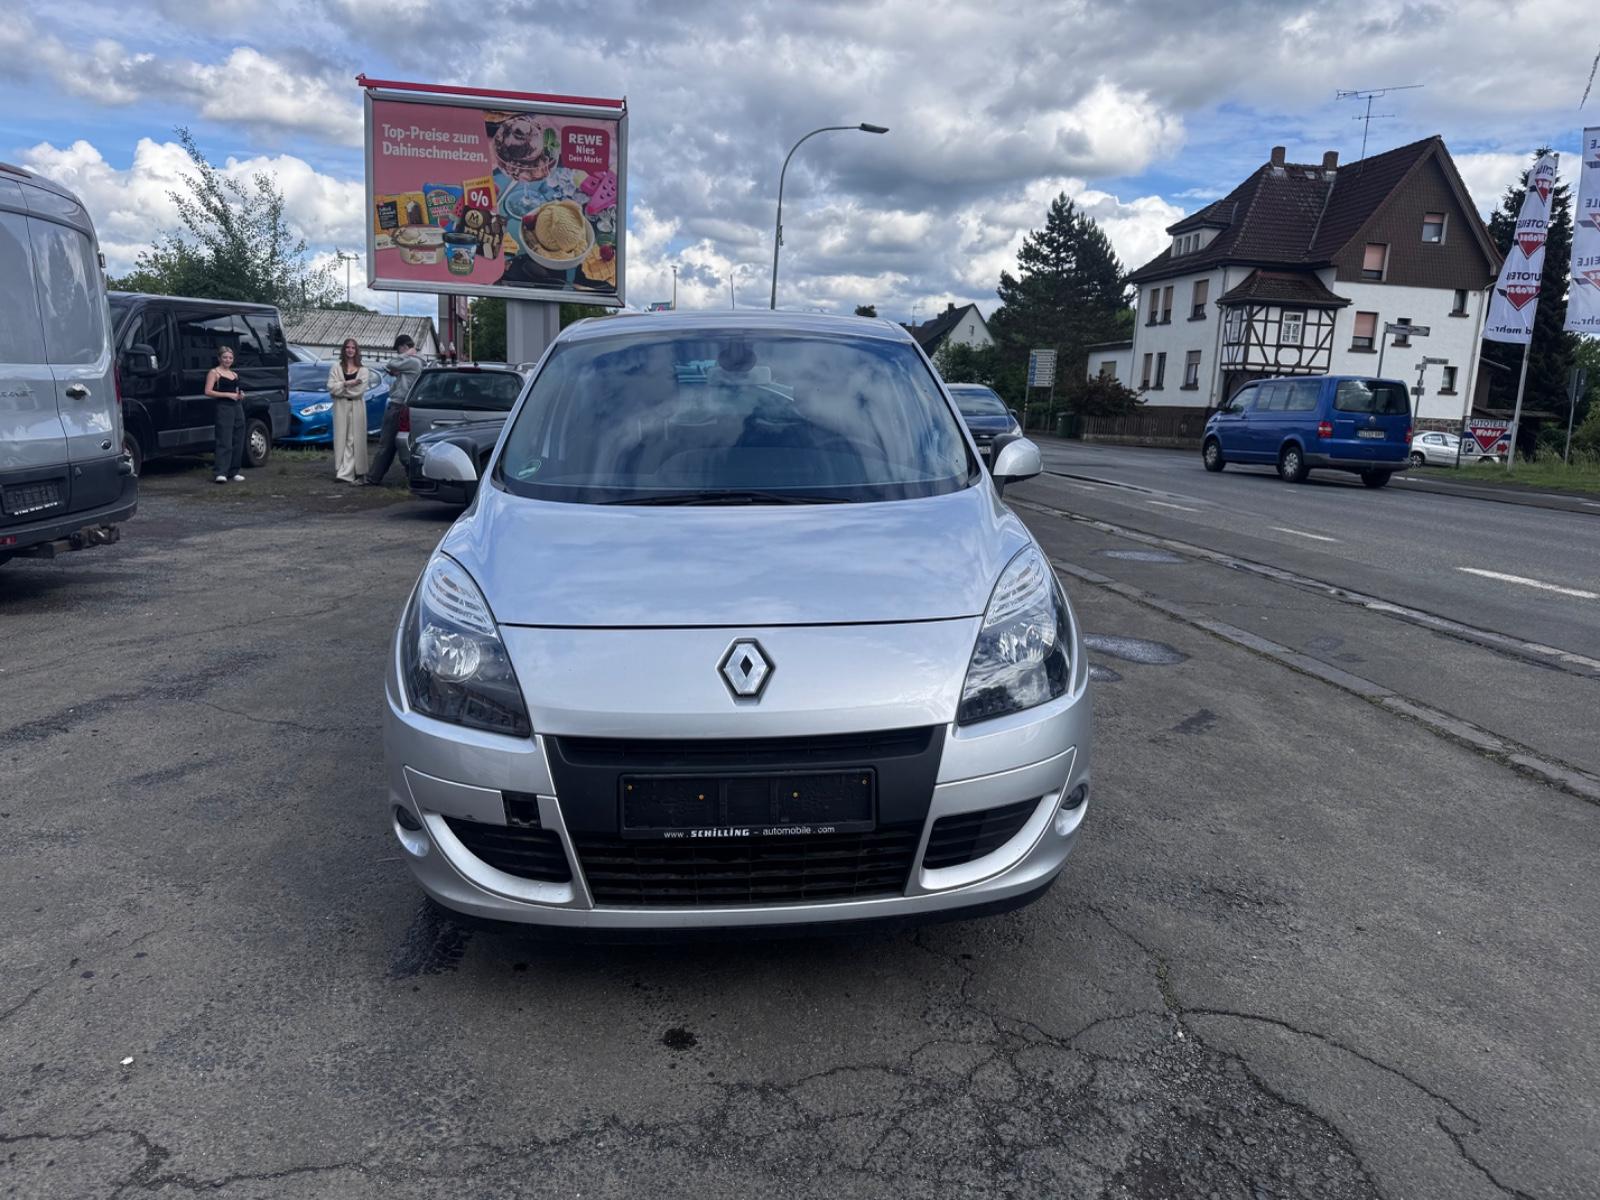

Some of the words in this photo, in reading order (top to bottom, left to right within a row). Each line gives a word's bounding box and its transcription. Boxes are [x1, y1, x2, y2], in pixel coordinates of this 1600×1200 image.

[382, 123, 450, 142] Top-Preise
[452, 132, 480, 145] zum
[568, 132, 603, 146] REWE
[382, 140, 488, 162] Dahinschmelzen.
[576, 144, 596, 155] Nies
[568, 153, 582, 163] Dein
[471, 190, 489, 207] %
